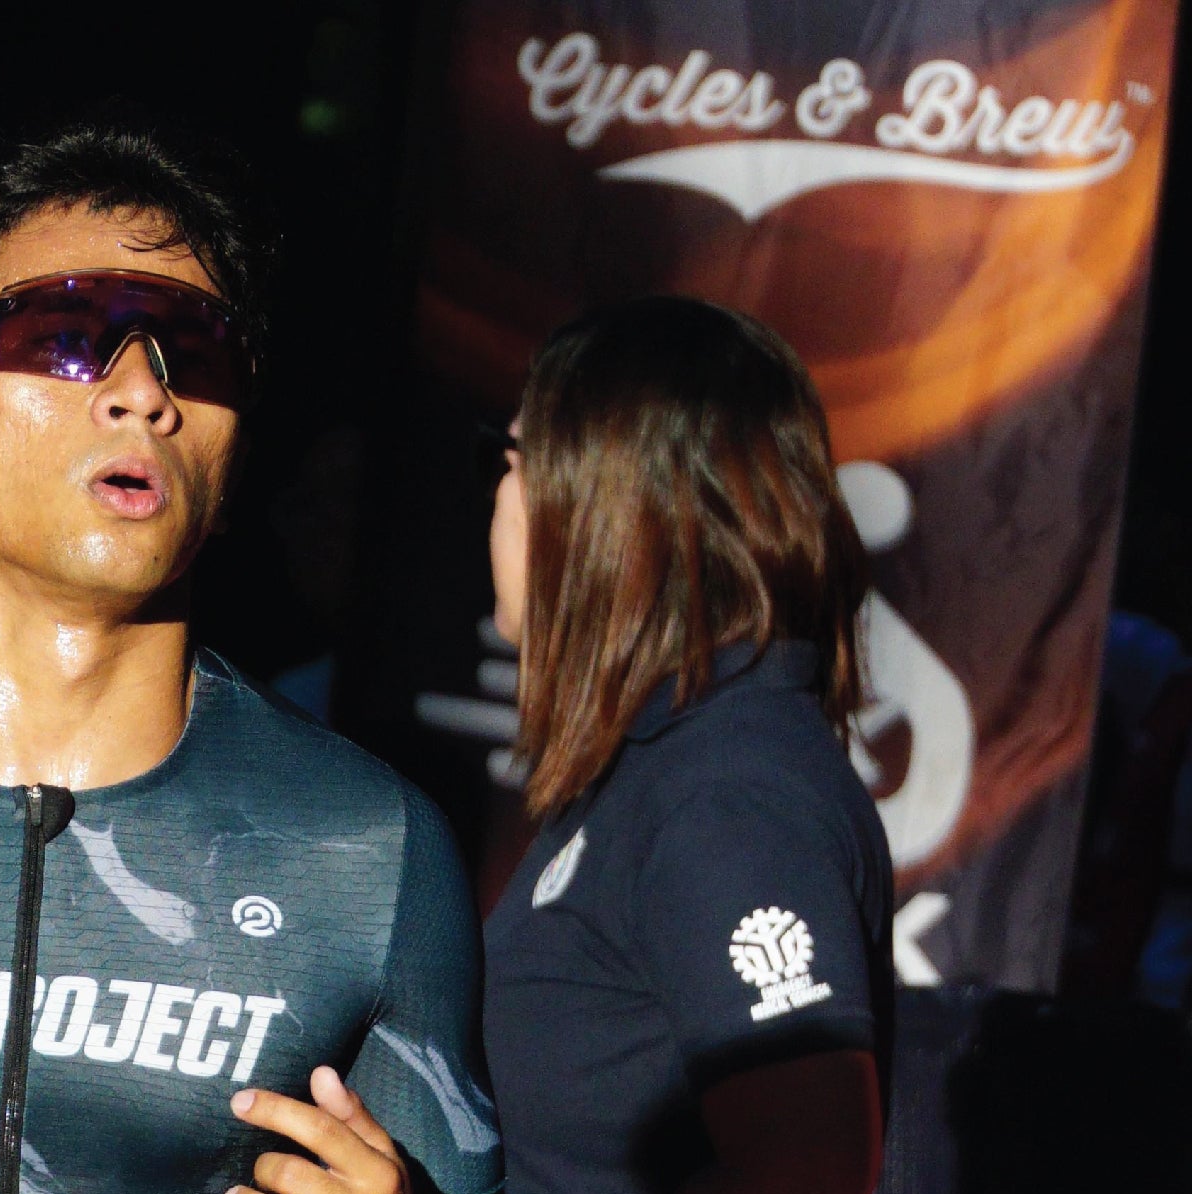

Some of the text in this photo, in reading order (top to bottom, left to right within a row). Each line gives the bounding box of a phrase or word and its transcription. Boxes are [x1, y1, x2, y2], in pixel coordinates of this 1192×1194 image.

[518, 32, 787, 148] Cycles
[795, 57, 873, 139] &
[876, 58, 1133, 158] Brew
